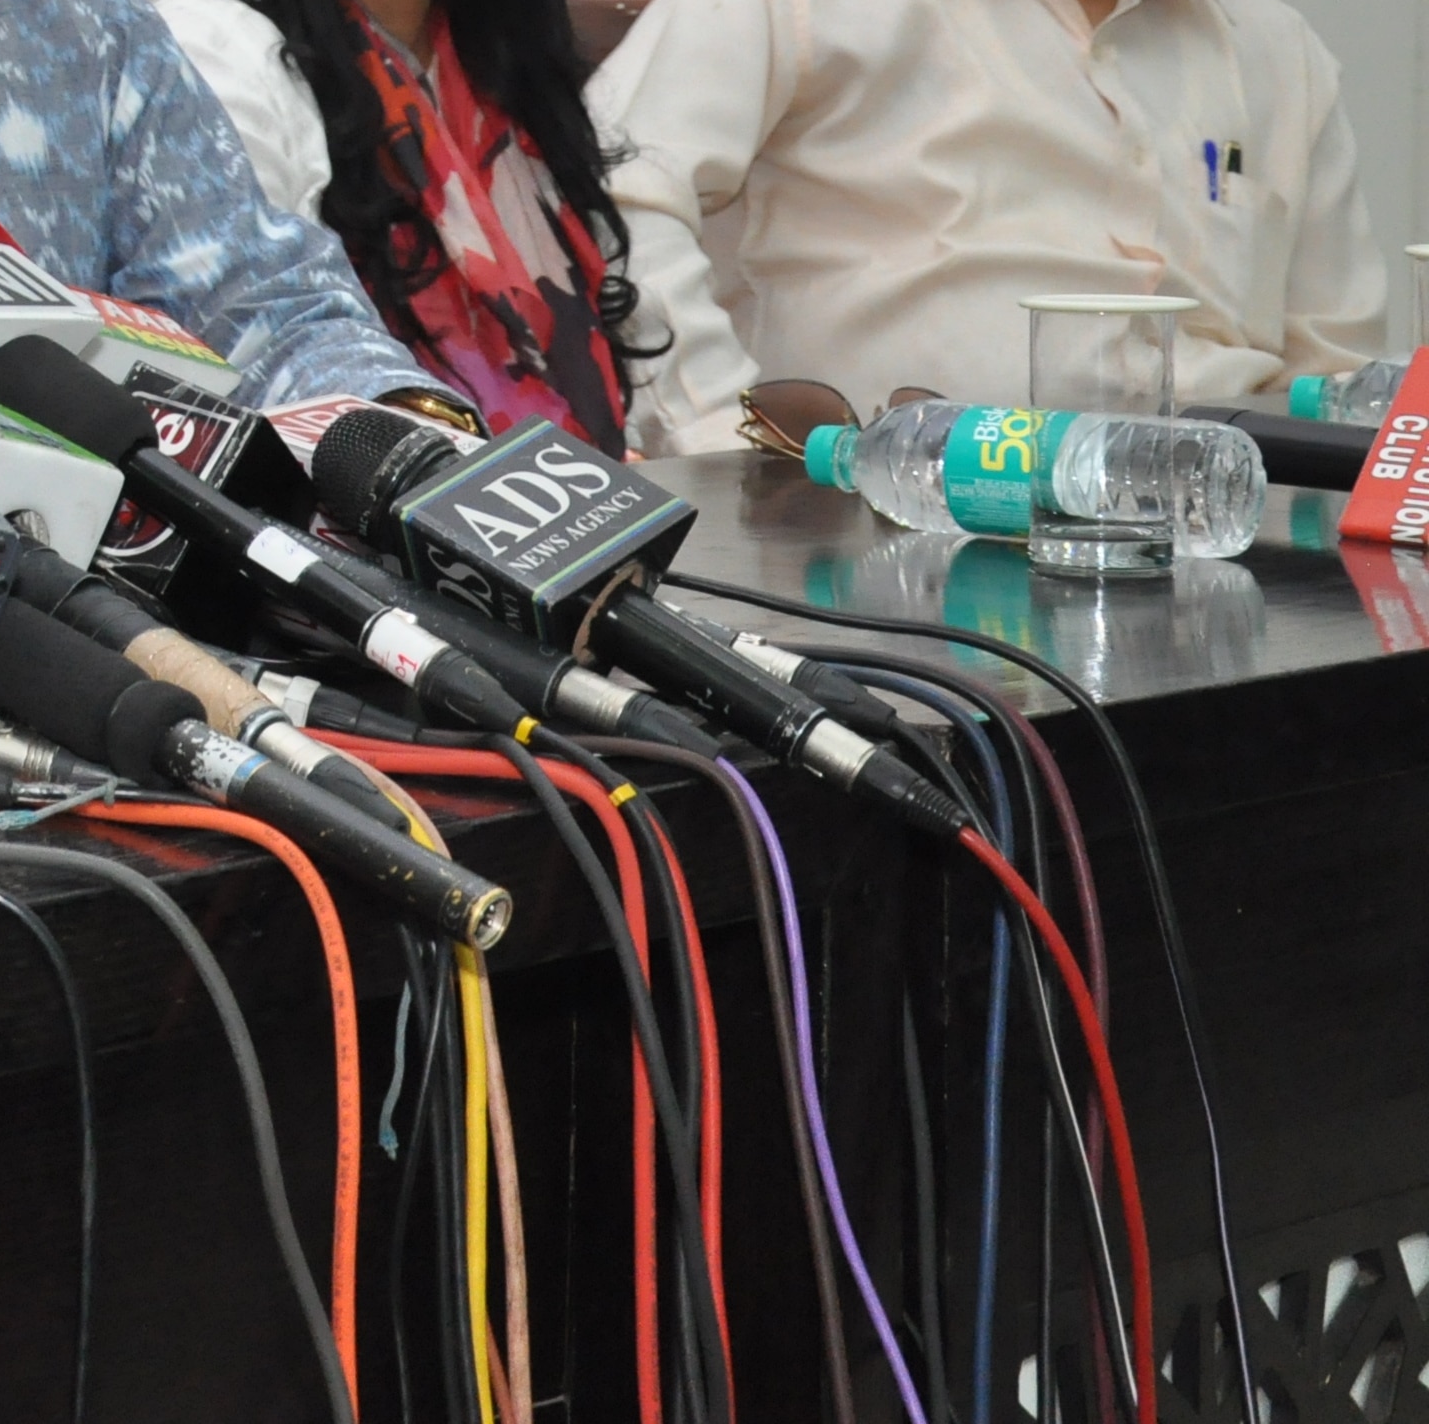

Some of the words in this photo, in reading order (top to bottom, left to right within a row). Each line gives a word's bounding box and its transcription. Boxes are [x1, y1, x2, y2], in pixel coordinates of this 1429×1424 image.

[1372, 415, 1429, 480] CLUB
[454, 442, 611, 557] ADS
[508, 533, 570, 575] NEWS
[565, 486, 644, 541] AGENCY
